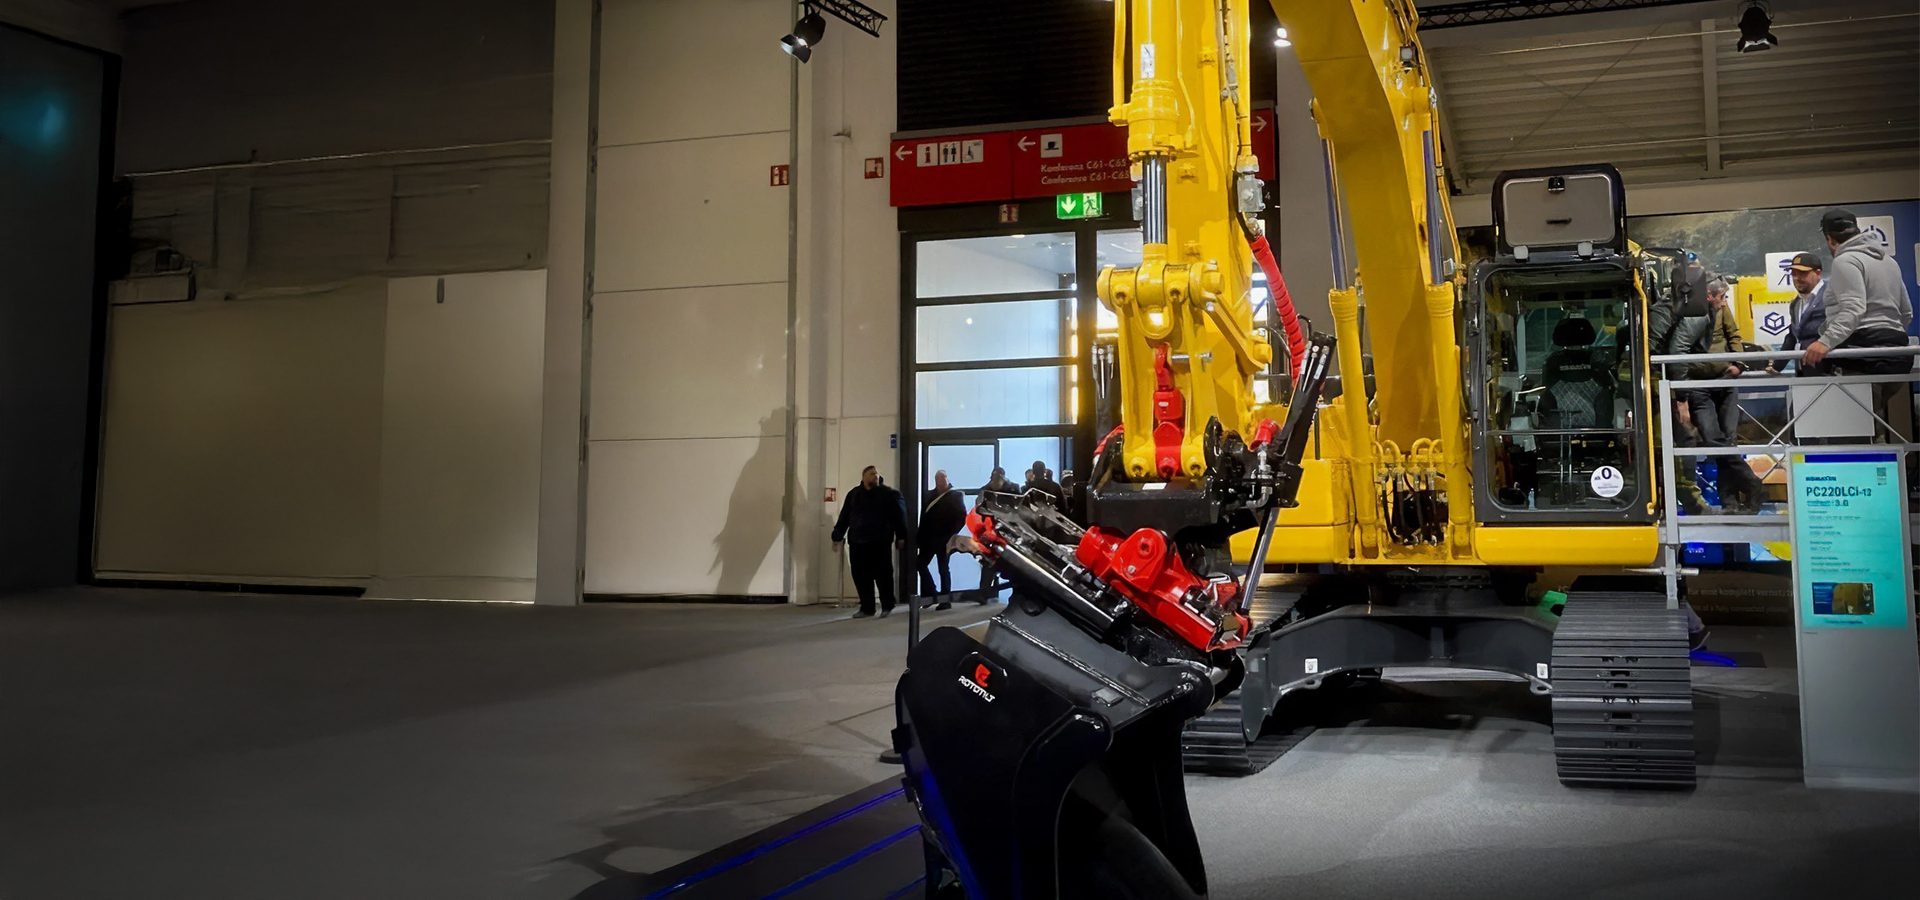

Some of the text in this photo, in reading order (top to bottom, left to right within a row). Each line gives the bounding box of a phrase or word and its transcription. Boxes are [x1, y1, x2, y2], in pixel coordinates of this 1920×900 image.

[1041, 163, 1084, 173] Konferenz
[1041, 174, 1088, 185] Conference
[1806, 486, 1872, 497] PC220LCi-12
[958, 675, 996, 703] ROTOTILT
